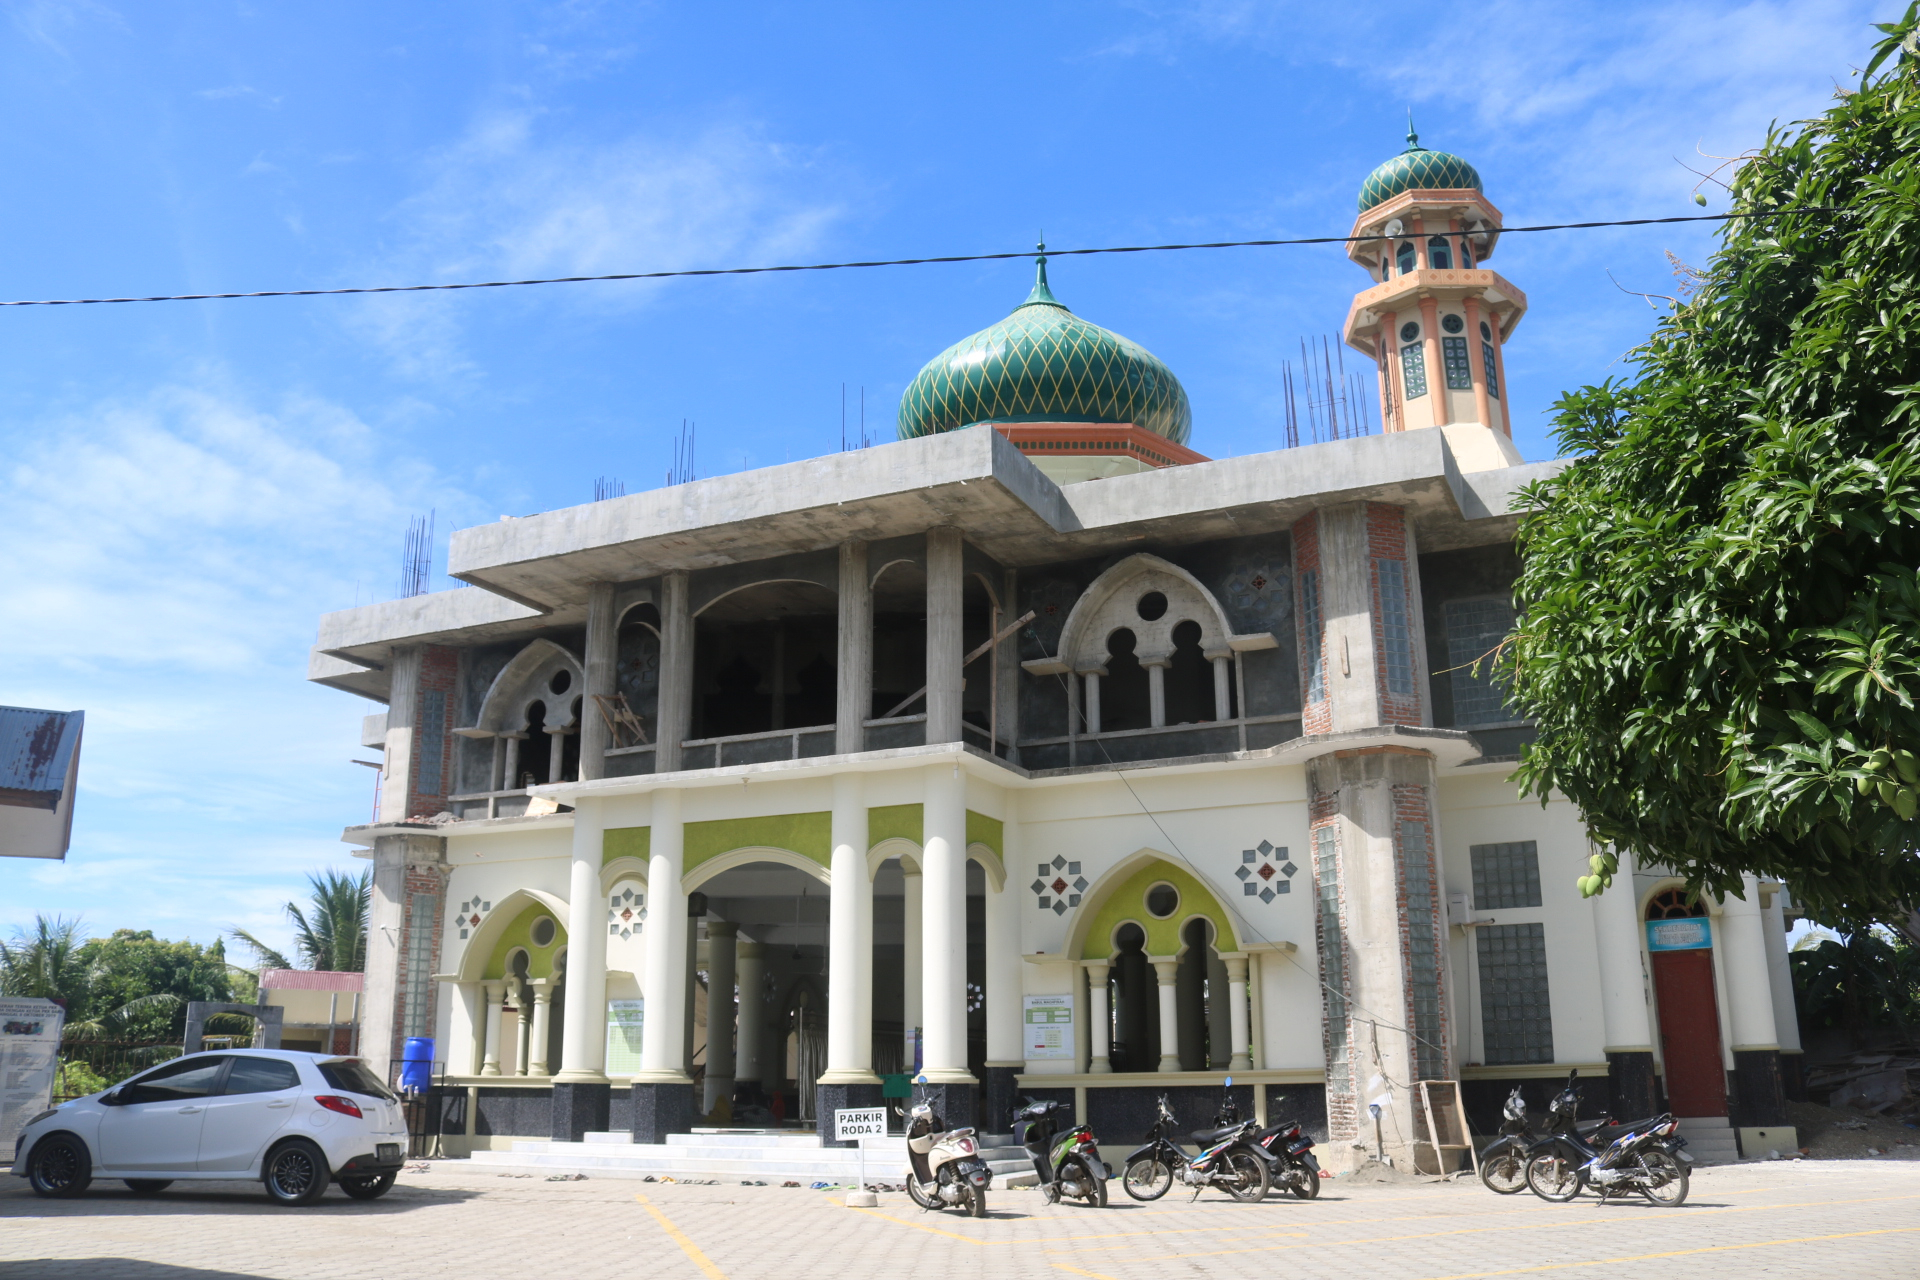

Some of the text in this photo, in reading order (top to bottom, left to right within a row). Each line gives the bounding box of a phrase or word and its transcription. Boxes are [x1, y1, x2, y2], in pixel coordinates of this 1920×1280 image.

[1654, 924, 1701, 933] SEKRETARIAT
[840, 1113, 882, 1123] PARKIR
[842, 1125, 882, 1134] RODA 2
